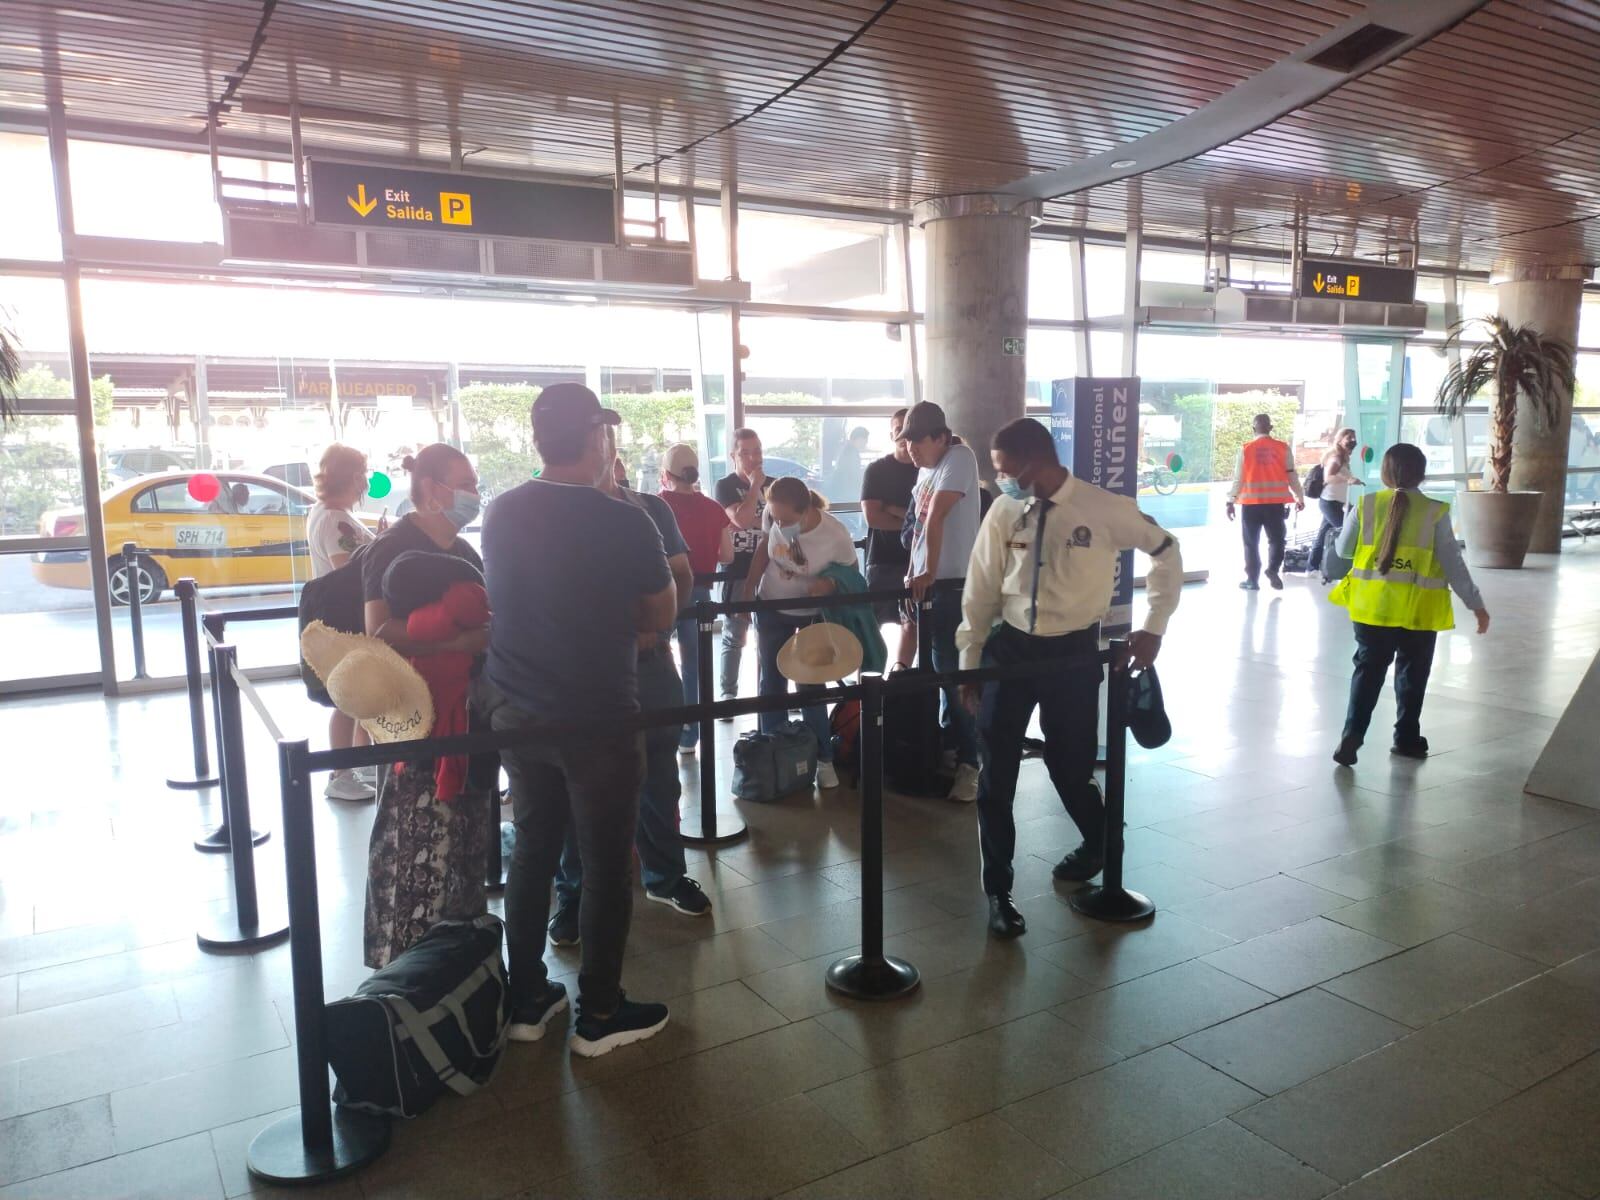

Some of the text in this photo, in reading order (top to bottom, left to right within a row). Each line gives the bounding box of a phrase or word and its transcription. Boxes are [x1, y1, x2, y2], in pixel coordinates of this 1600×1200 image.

[384, 189, 410, 203] Exit
[386, 204, 433, 221] Salida
[448, 198, 465, 219] P
[297, 381, 417, 396] PARUEADERO
[1091, 387, 1104, 489] ternacional
[1105, 387, 1128, 489] Núñez
[177, 530, 223, 545] SPH 714
